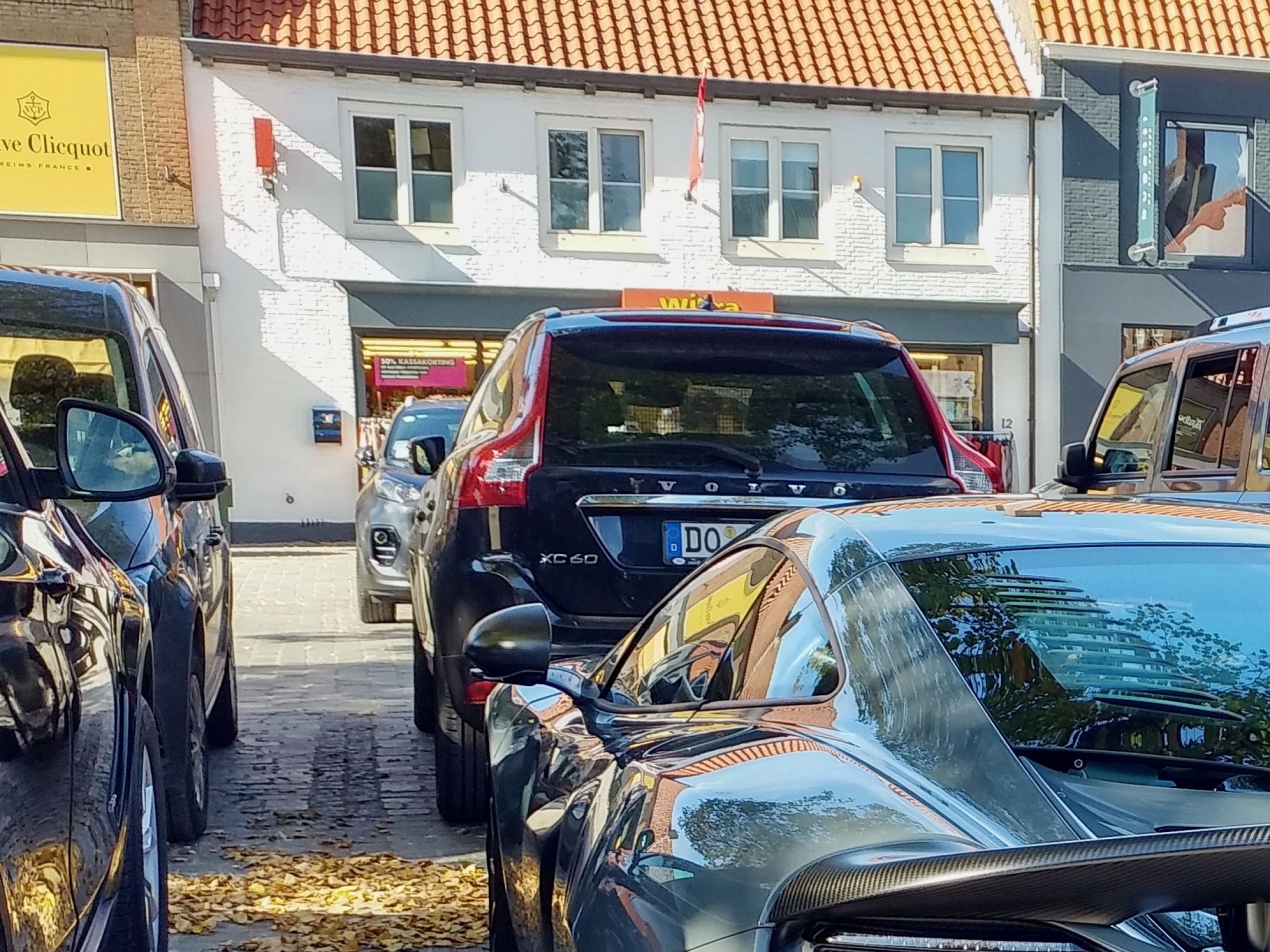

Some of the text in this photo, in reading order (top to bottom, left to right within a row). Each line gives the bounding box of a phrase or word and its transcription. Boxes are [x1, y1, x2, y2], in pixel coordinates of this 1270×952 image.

[27, 133, 112, 160] Clicquot
[38, 162, 80, 171] FRANCE
[657, 480, 847, 496] VOLVO
[684, 526, 721, 553] DO
